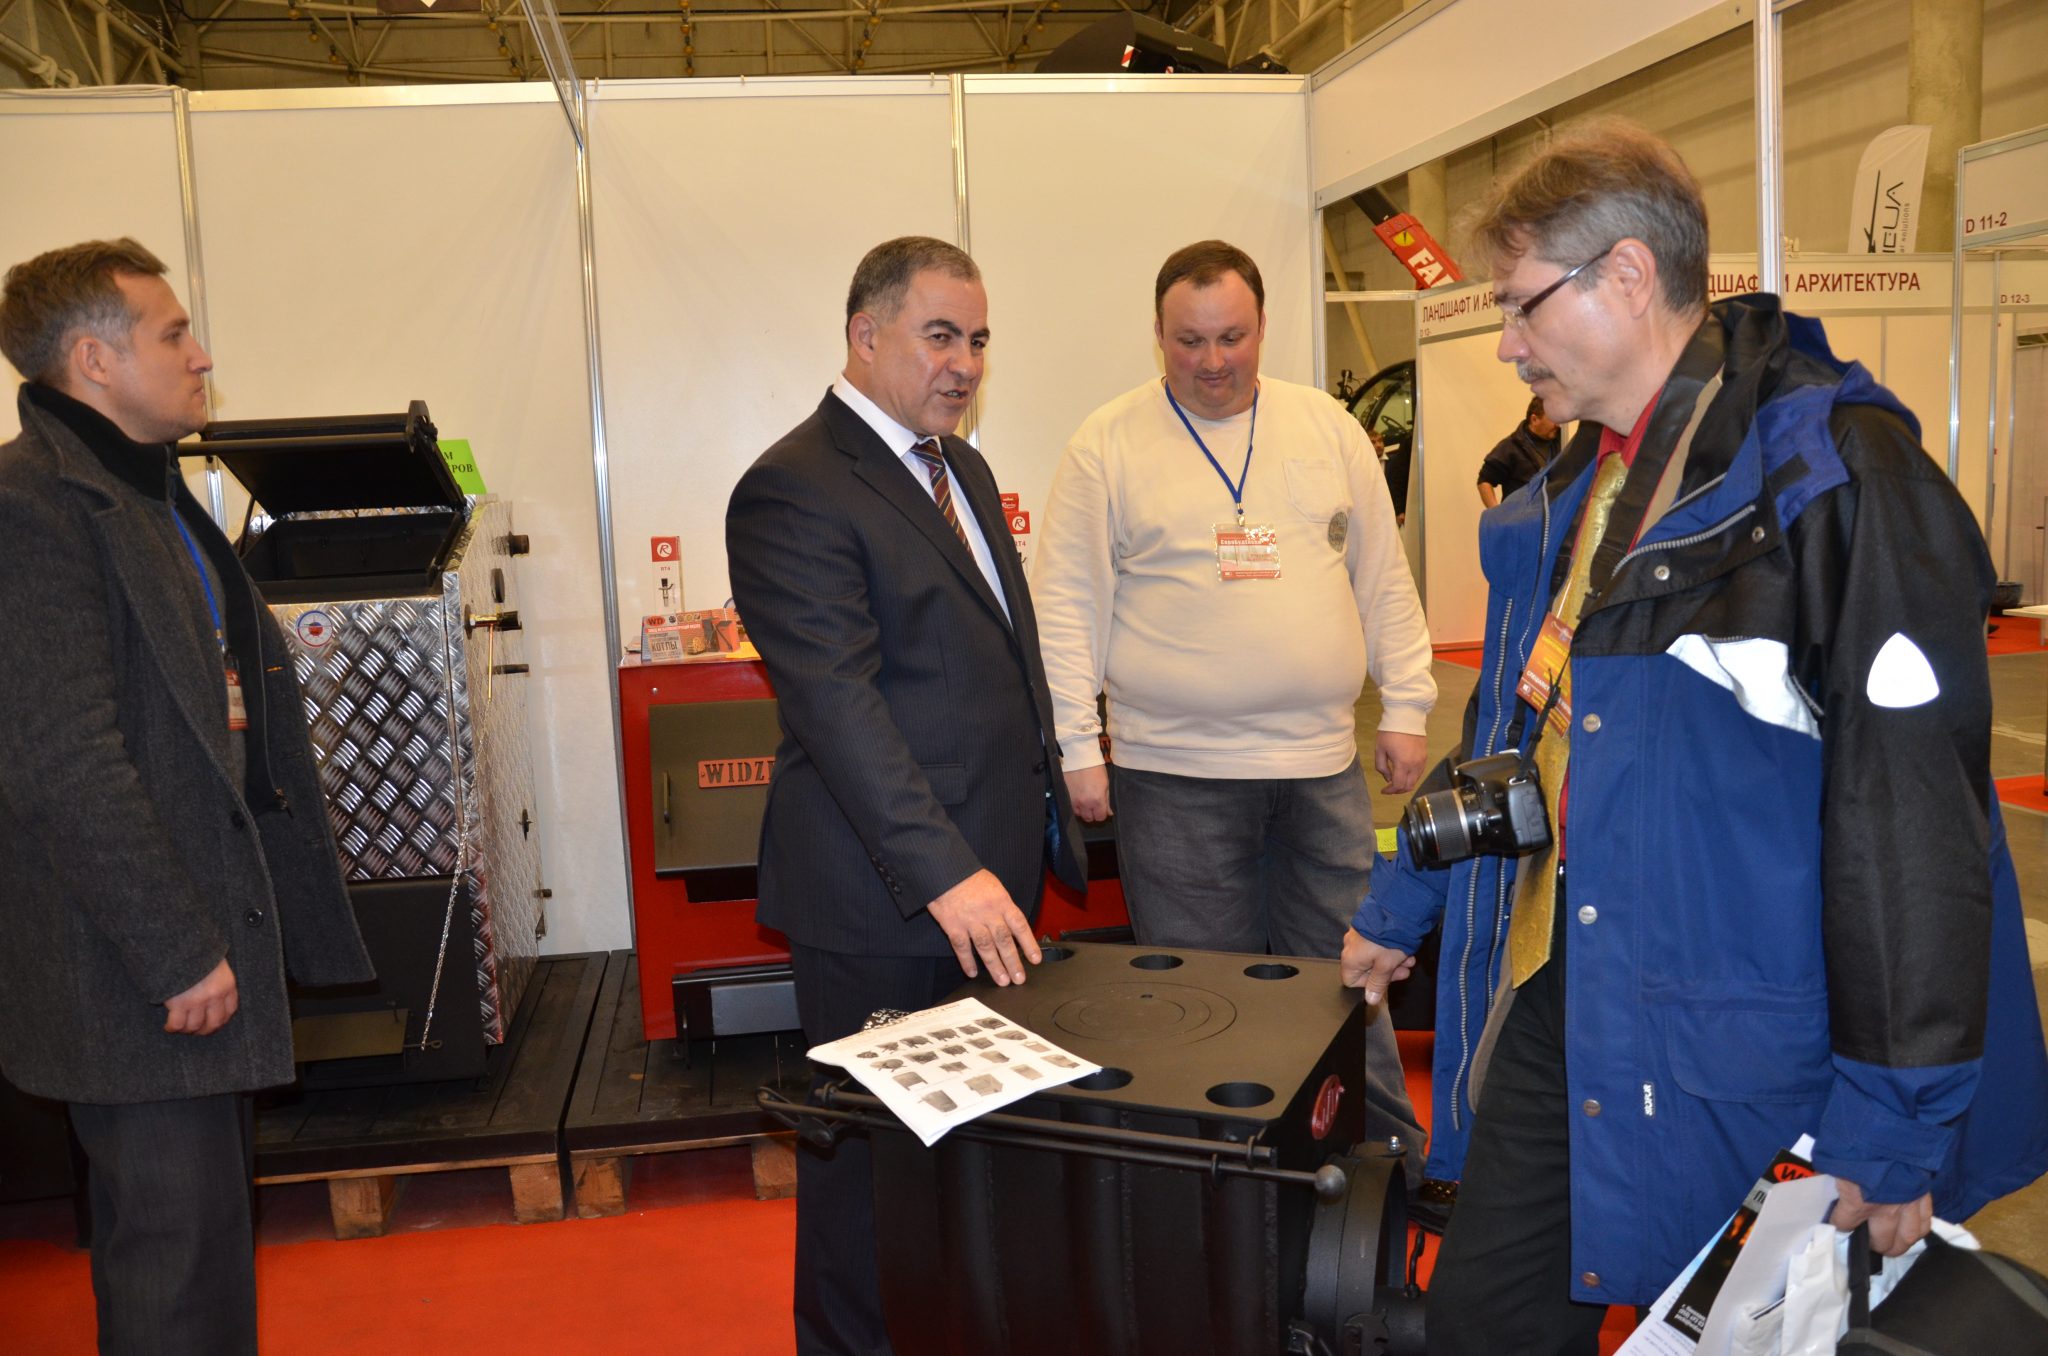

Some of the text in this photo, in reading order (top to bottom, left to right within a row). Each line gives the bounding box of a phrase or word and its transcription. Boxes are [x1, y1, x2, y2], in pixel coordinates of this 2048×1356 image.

[1965, 211, 2008, 234] D 11-2
[1795, 272, 1921, 292] АРХИТЕКТУРА
[1422, 296, 1471, 323] ЛАНДШАФТ
[1473, 294, 1480, 312] И
[2000, 294, 2030, 304] D 12-3
